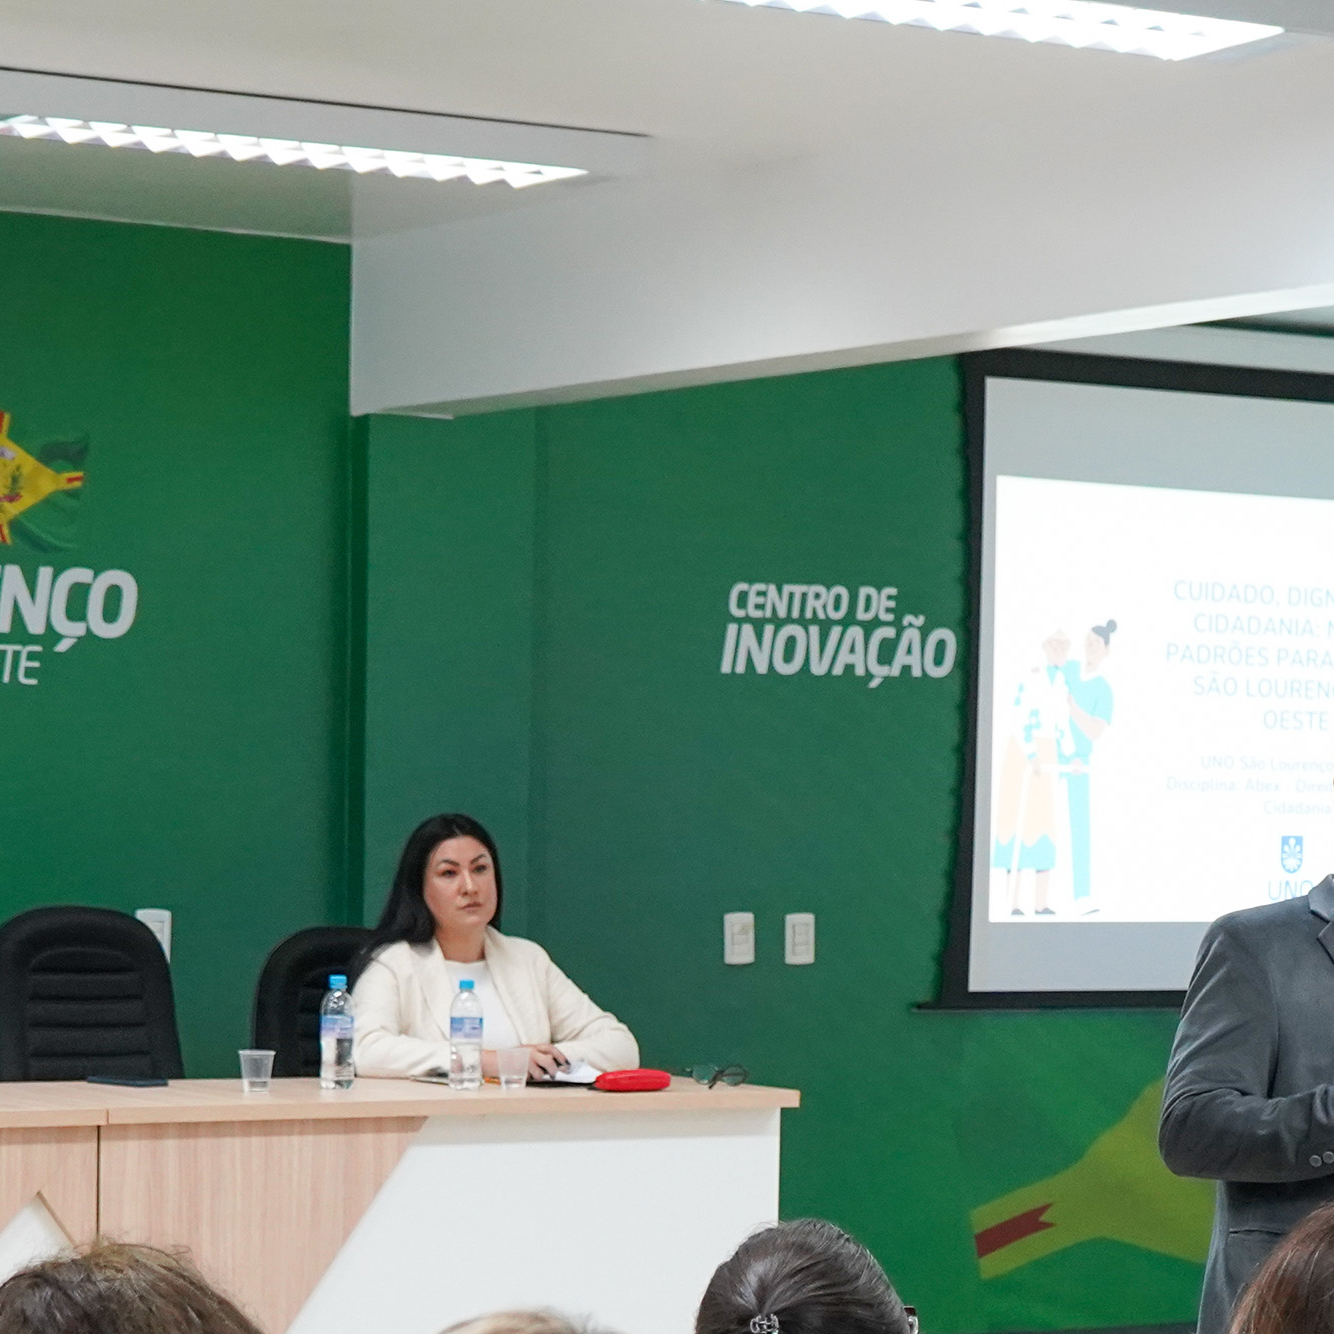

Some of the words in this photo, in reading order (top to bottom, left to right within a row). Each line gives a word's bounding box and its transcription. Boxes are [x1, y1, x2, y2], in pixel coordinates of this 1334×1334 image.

[728, 582, 850, 621] CENTRO
[856, 586, 898, 622] DE
[720, 614, 958, 689] INOVAÇÃO
[1165, 640, 1270, 668] PADRÕES
[1276, 647, 1334, 669] PARA
[1193, 670, 1238, 697] SÃO
[1263, 709, 1330, 732] OESTE
[1200, 755, 1235, 769] UNO
[1239, 755, 1266, 771] São
[1263, 800, 1331, 815] Cidadania
